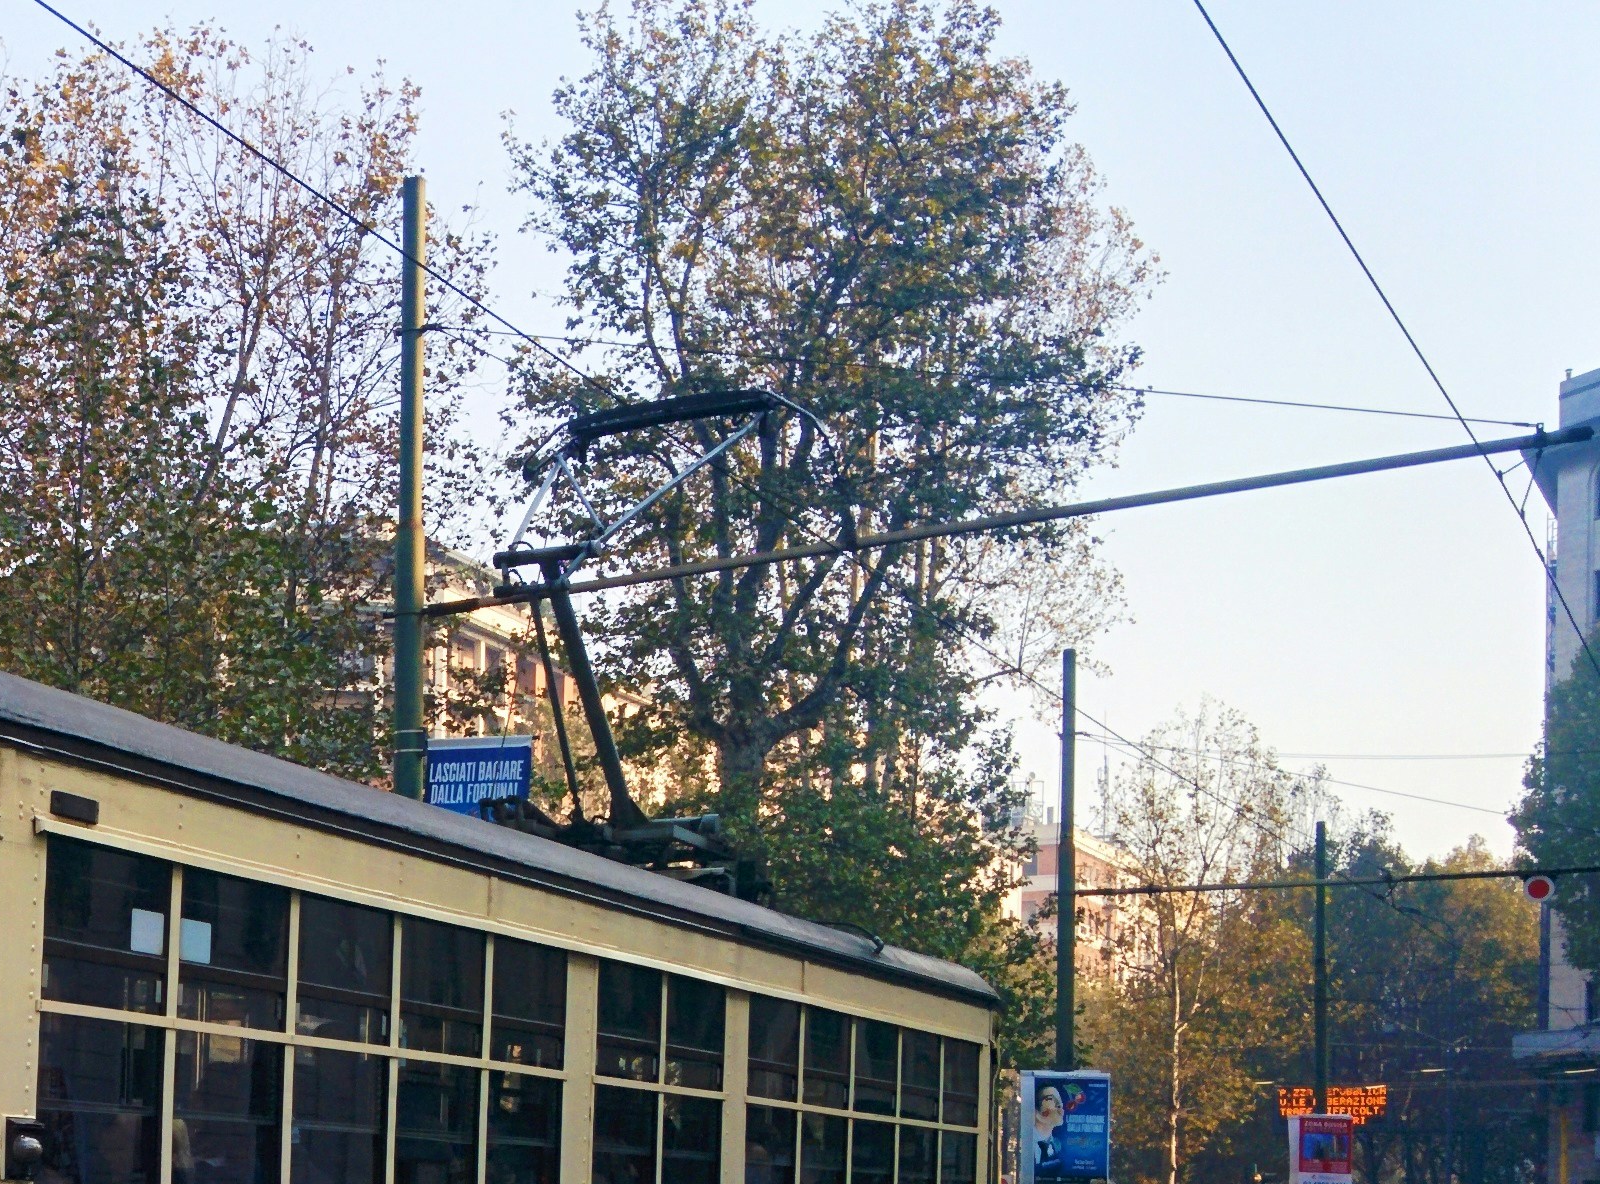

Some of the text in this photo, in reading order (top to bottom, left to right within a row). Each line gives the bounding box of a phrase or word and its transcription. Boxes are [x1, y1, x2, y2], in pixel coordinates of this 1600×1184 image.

[429, 760, 524, 782] LASCIATI BACIARE
[430, 783, 464, 804] DALLA
[1326, 1086, 1387, 1096] EPUBBLICA
[1326, 1106, 1385, 1116] IFFICOLT.
